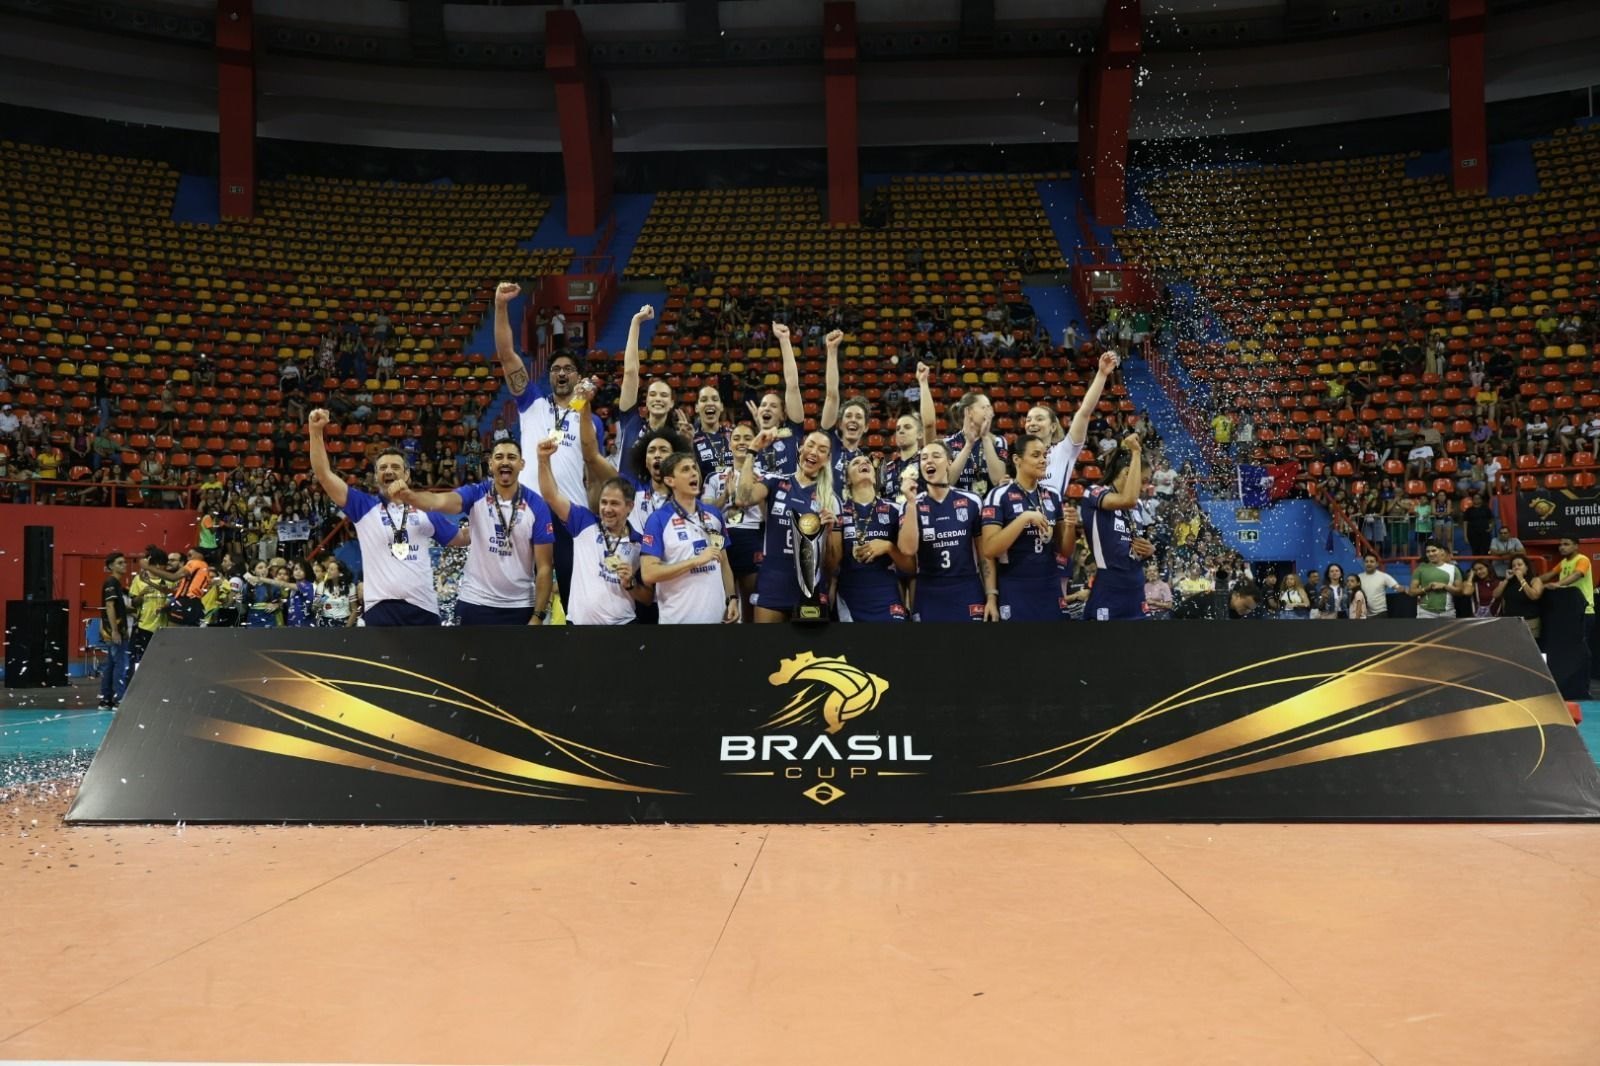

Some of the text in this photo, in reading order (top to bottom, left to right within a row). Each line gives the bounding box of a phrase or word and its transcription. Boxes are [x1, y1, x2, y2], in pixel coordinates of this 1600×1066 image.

[936, 529, 967, 539] GERDAU
[932, 540, 959, 549] minas
[940, 550, 951, 569] 3
[720, 735, 933, 761] BRASIL
[785, 767, 867, 779] CUP
